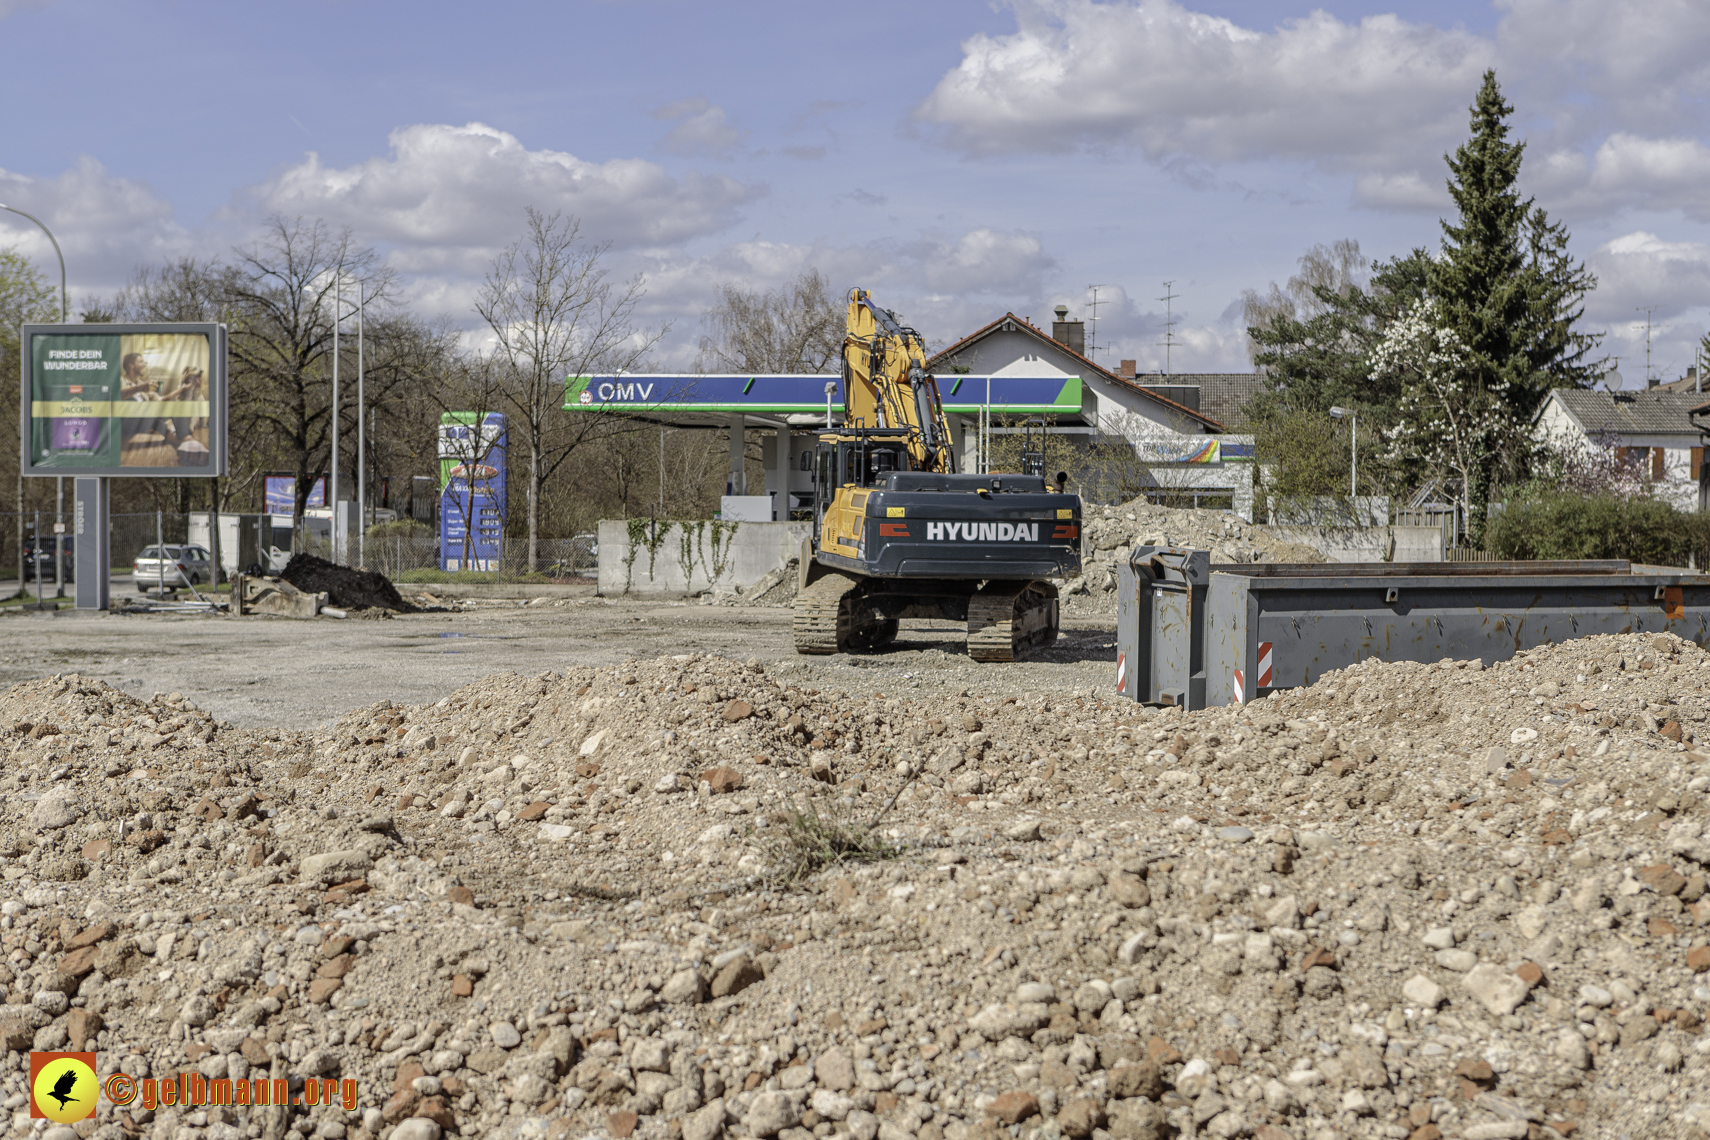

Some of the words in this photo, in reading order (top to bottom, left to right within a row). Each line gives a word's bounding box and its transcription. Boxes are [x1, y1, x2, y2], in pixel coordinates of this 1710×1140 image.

[49, 350, 78, 359] FINDE
[79, 350, 102, 359] DEIN
[43, 361, 108, 370] WUNDERBAR
[598, 382, 654, 401] OMV
[60, 406, 93, 414] JACOBS
[926, 522, 1039, 542] HYUNDAI
